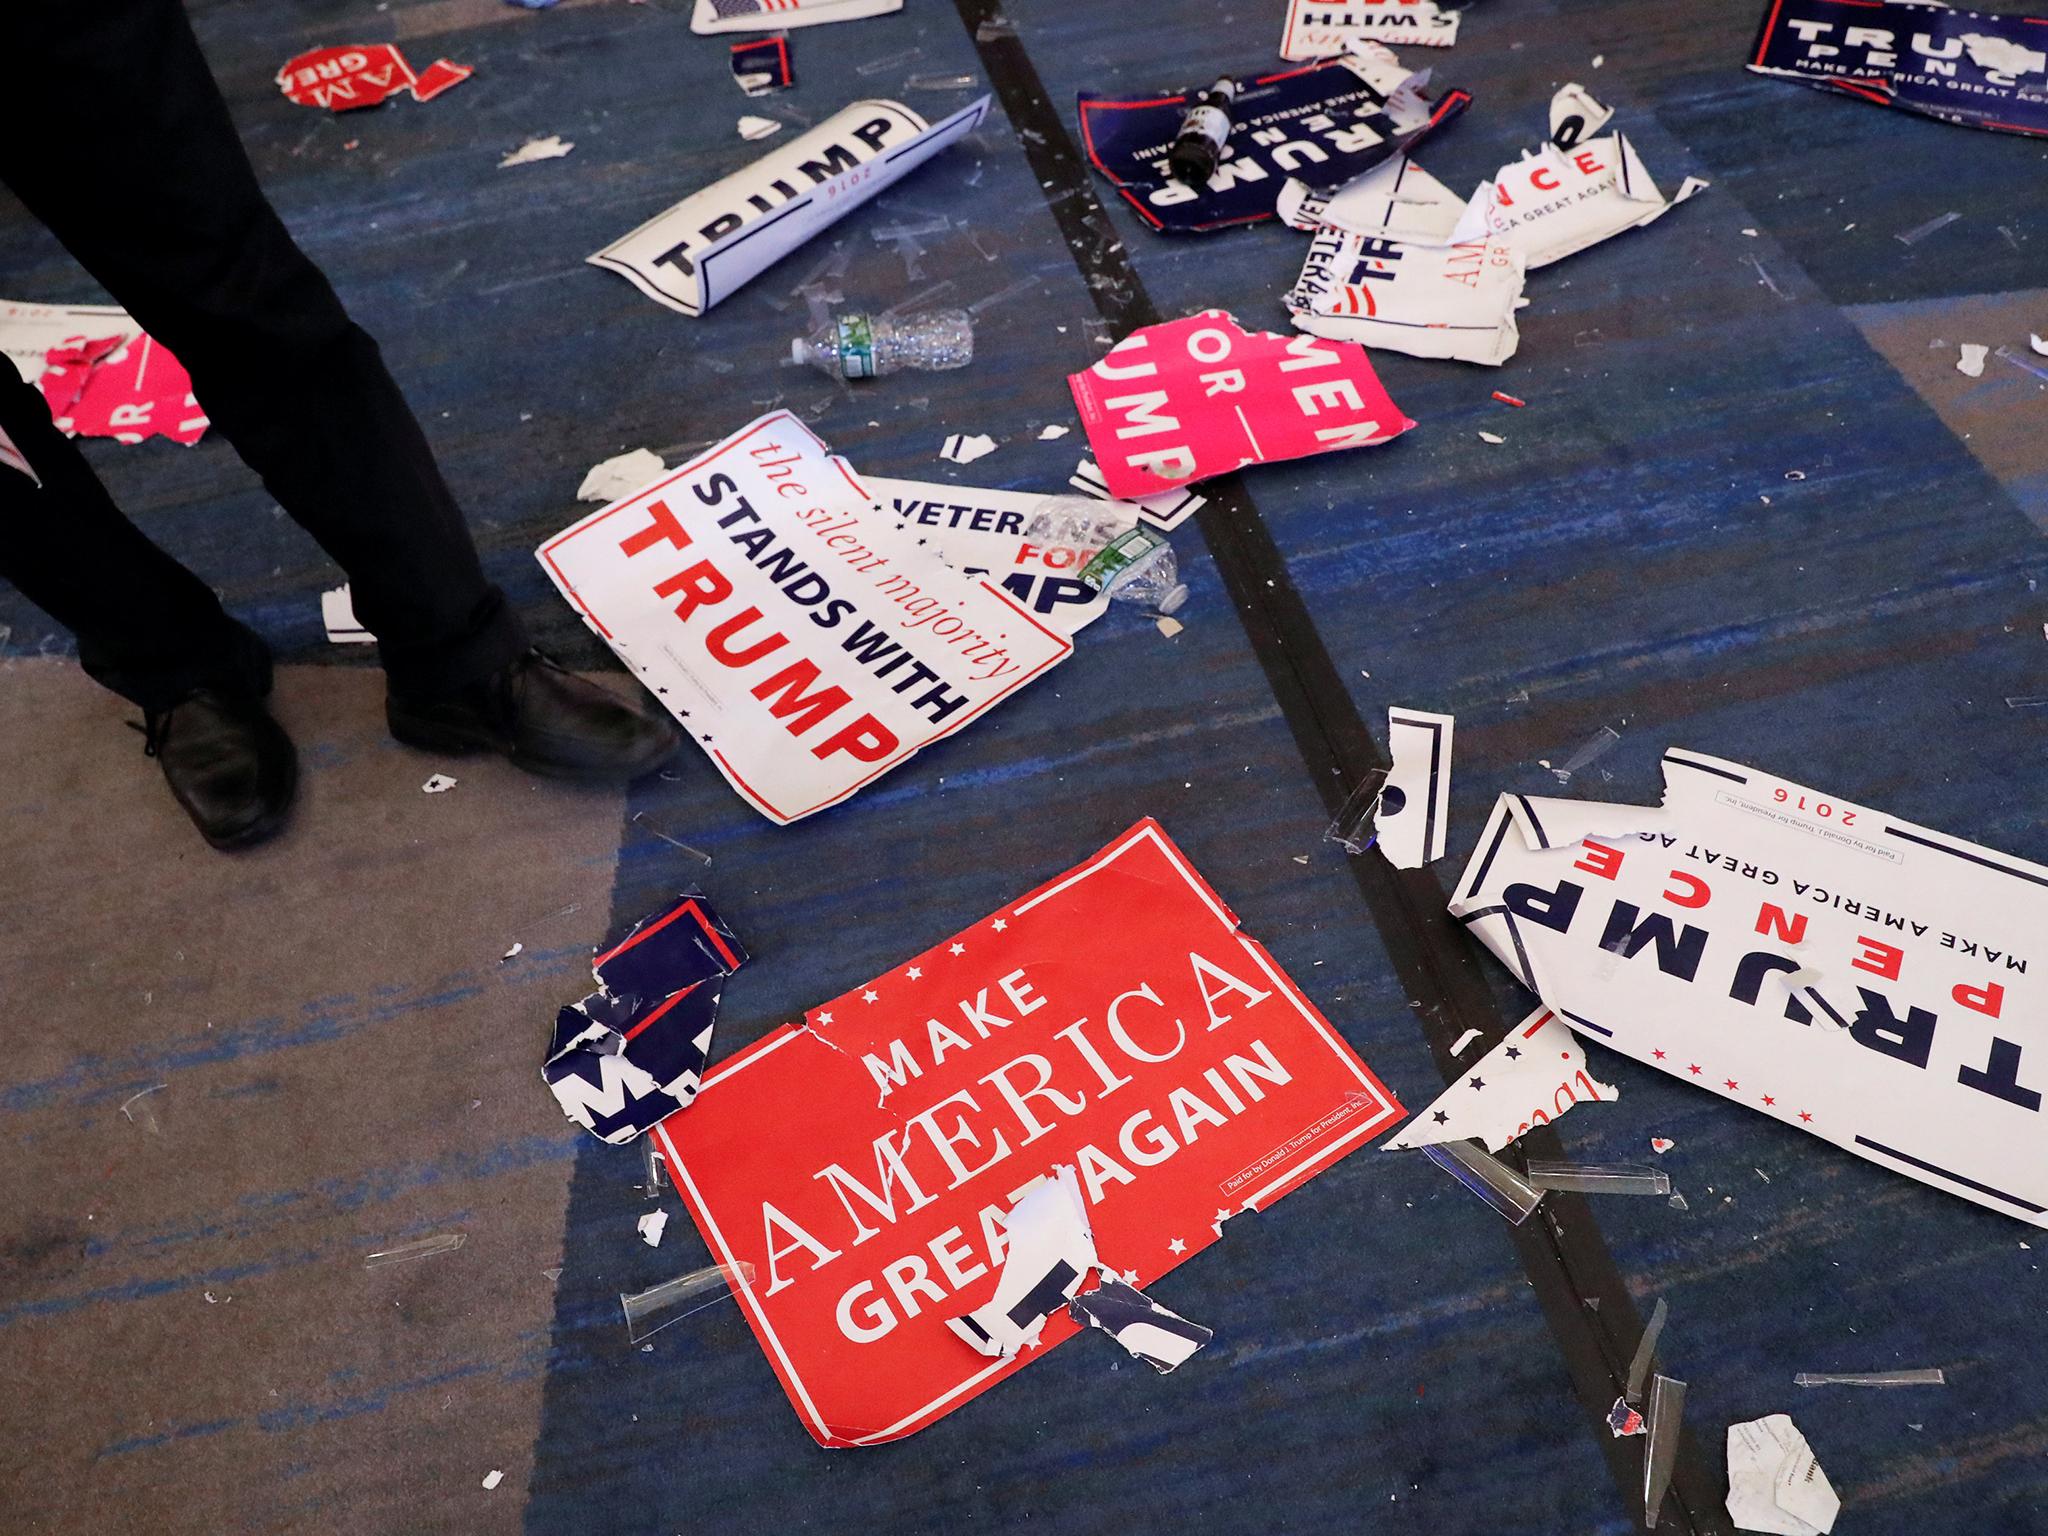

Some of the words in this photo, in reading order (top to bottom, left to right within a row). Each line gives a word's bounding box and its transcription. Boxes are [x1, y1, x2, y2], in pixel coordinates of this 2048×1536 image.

[1303, 13, 1417, 27] WITH
[1788, 19, 1963, 59] TRU
[1796, 58, 1847, 75] MAKE
[1852, 67, 1939, 87] AMRICA
[1946, 80, 2009, 99] GREAT
[1808, 44, 2048, 92] PENC
[1249, 100, 1321, 128] AMERICA
[1522, 196, 1572, 222] GREAT
[1187, 320, 1246, 398] OR
[750, 441, 809, 499] the
[796, 499, 886, 575] silent
[874, 573, 1021, 683] majority
[692, 471, 856, 629] STANDS
[841, 619, 969, 725] WITH
[618, 499, 900, 764] TRUMP
[1773, 788, 1856, 826] 2016
[1777, 814, 1789, 824] for
[1788, 817, 1815, 832] Trump
[1822, 829, 1852, 845] Donald
[1851, 838, 1864, 849] by
[1862, 843, 1877, 854] for
[1876, 848, 1896, 860] Paid
[1684, 842, 1780, 886] GREAT
[1573, 840, 2005, 1019] PENCE
[1788, 878, 1929, 938] AMERICA
[1938, 931, 2029, 974] MAKE
[1502, 880, 2048, 1112] TRUMP
[861, 968, 1047, 1096] MAKE
[762, 950, 1273, 1299] AMERICA
[1082, 1038, 1293, 1205] AGAIN
[1227, 1175, 1243, 1190] Paid
[1241, 1168, 1254, 1180] for
[1251, 1164, 1261, 1174] by
[1260, 1147, 1286, 1168] Donald
[1288, 1132, 1312, 1149] Trump
[1310, 1124, 1322, 1135] for
[1319, 1104, 1353, 1129] President,
